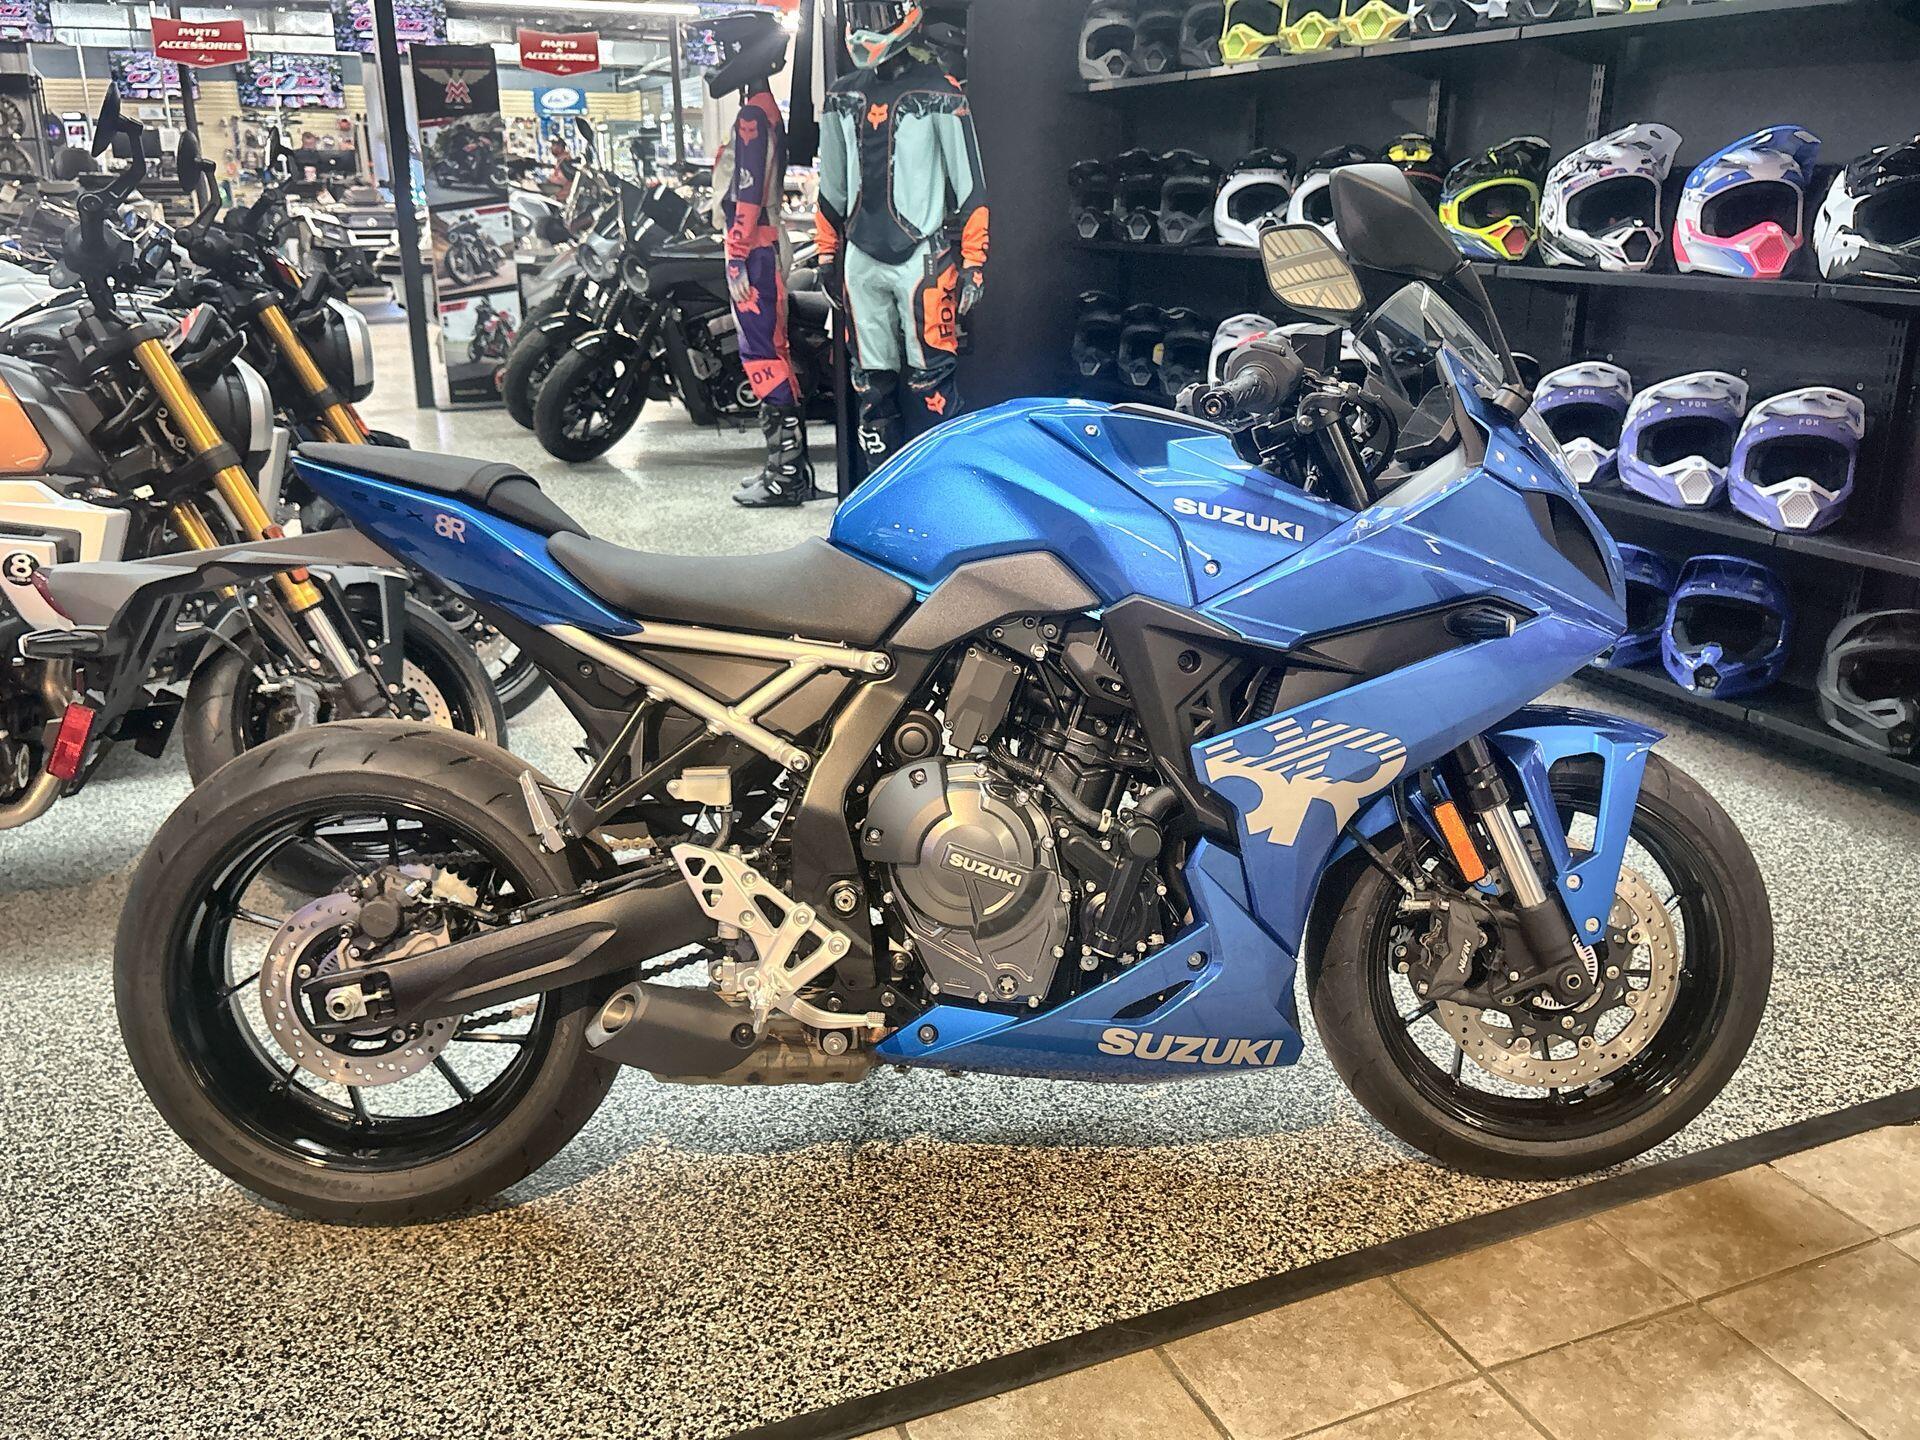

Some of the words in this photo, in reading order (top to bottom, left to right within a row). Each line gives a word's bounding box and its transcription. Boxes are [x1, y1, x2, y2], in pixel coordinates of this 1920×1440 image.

[177, 27, 220, 37] PARTS
[158, 40, 243, 51] ACCESSORIES
[524, 52, 596, 61] ACCESSORIES
[540, 40, 578, 49] PARTS
[939, 287, 957, 339] FOX
[752, 366, 775, 384] OX
[434, 513, 467, 544] 8R
[1172, 497, 1304, 542] SUZUKI
[10, 554, 32, 578] 8
[948, 852, 1022, 887] SUZUKI
[1097, 1027, 1284, 1066] SUZUKI
